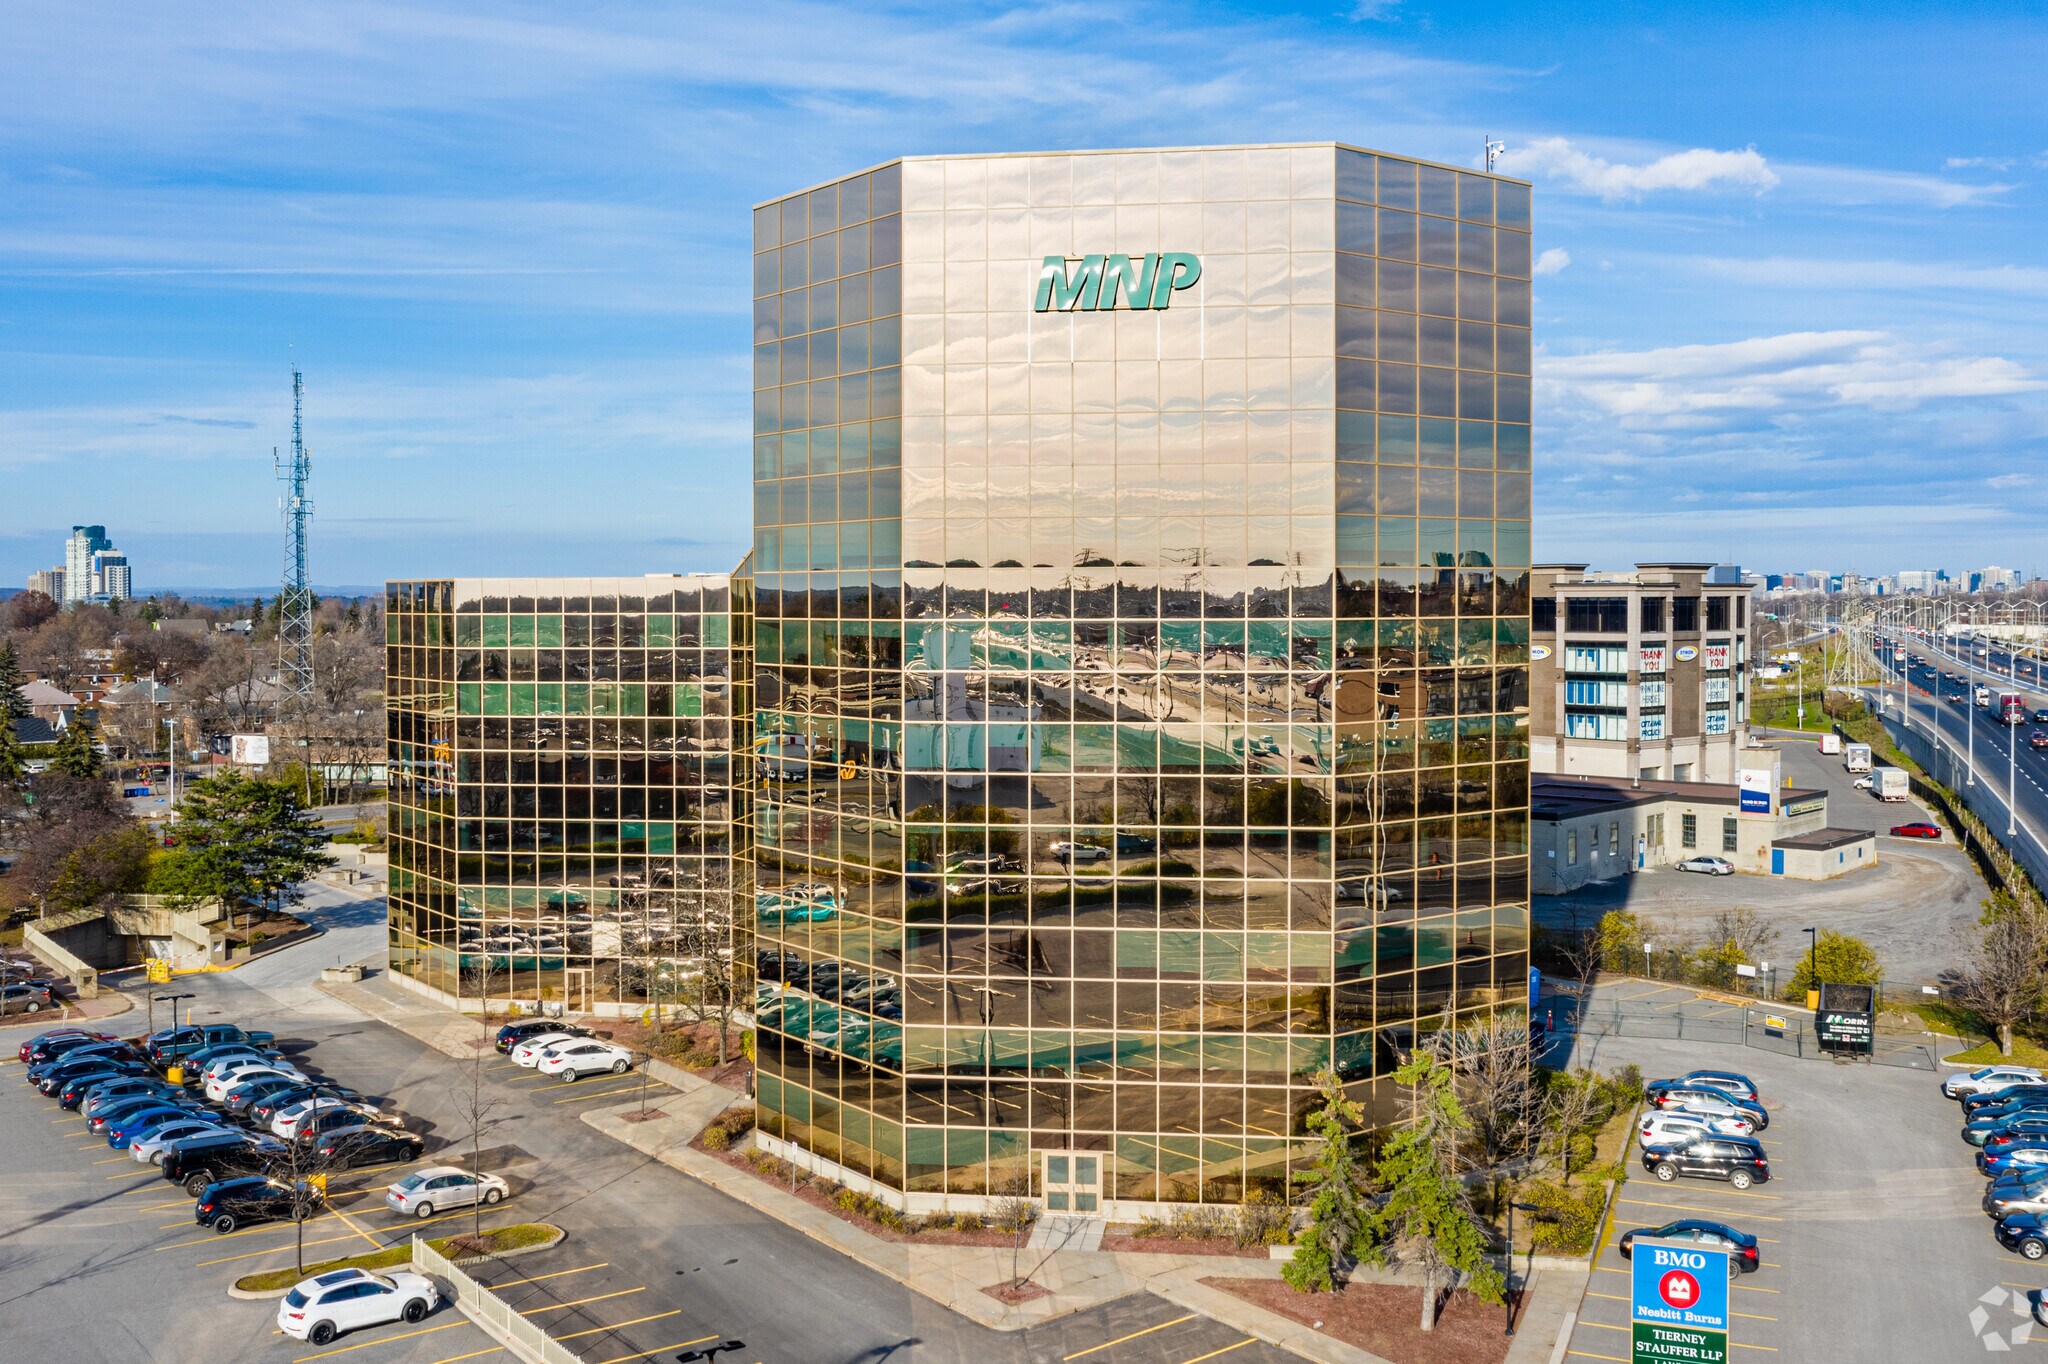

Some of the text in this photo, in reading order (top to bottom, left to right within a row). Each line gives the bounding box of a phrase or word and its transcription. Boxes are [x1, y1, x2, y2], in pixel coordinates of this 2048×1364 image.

[1034, 252, 1203, 313] MNP
[1640, 649, 1664, 660] THANK
[1706, 647, 1728, 657] THANK
[1644, 660, 1660, 671] YOU
[1709, 658, 1725, 667] YOU
[1825, 1014, 1868, 1026] MORIN
[1654, 1249, 1706, 1269] BMO
[1637, 1305, 1722, 1325] Nesbitt Burns
[1652, 1329, 1707, 1345] TIERNEY
[1636, 1341, 1723, 1361] STAUFFER LLP
